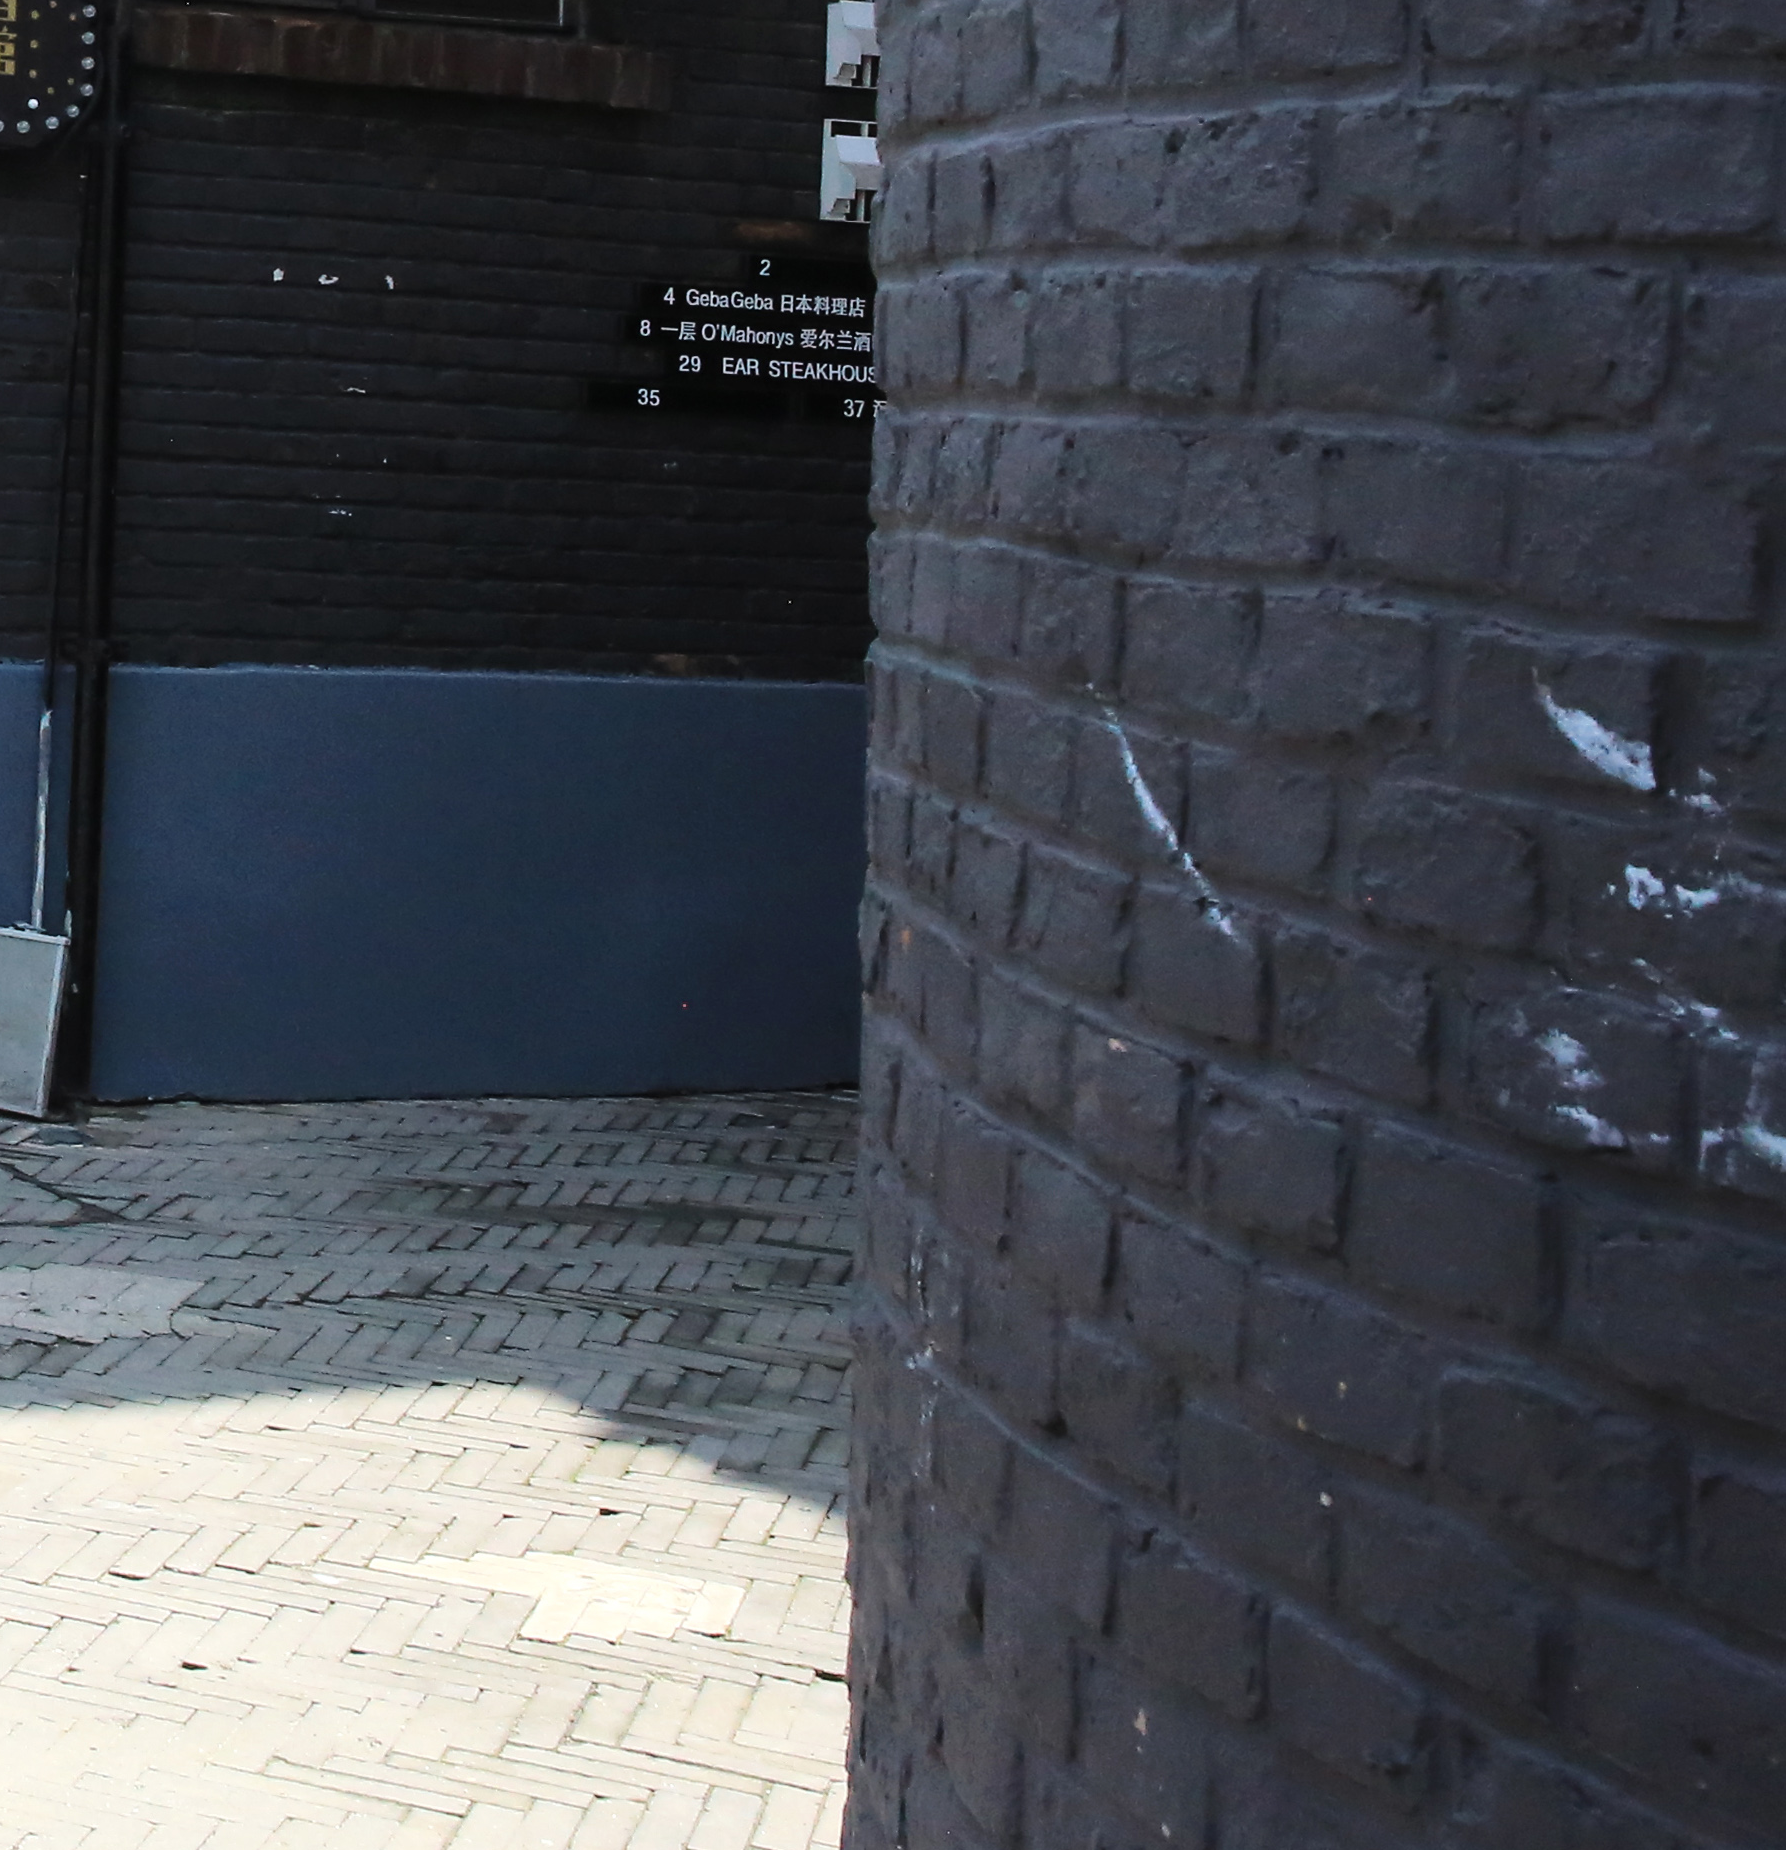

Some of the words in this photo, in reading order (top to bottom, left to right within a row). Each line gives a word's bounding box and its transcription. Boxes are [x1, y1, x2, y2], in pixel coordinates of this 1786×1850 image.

[759, 259, 771, 276] 2
[663, 286, 675, 306] 4
[686, 288, 774, 311] GebaGeba
[780, 294, 866, 318] 日本料理店
[640, 319, 651, 337] 8
[660, 321, 696, 341] 一层
[701, 323, 794, 349] O'Mahonys
[678, 354, 701, 373] 29
[722, 357, 760, 376] EAR
[637, 388, 661, 407] 35
[843, 398, 865, 418] 37
